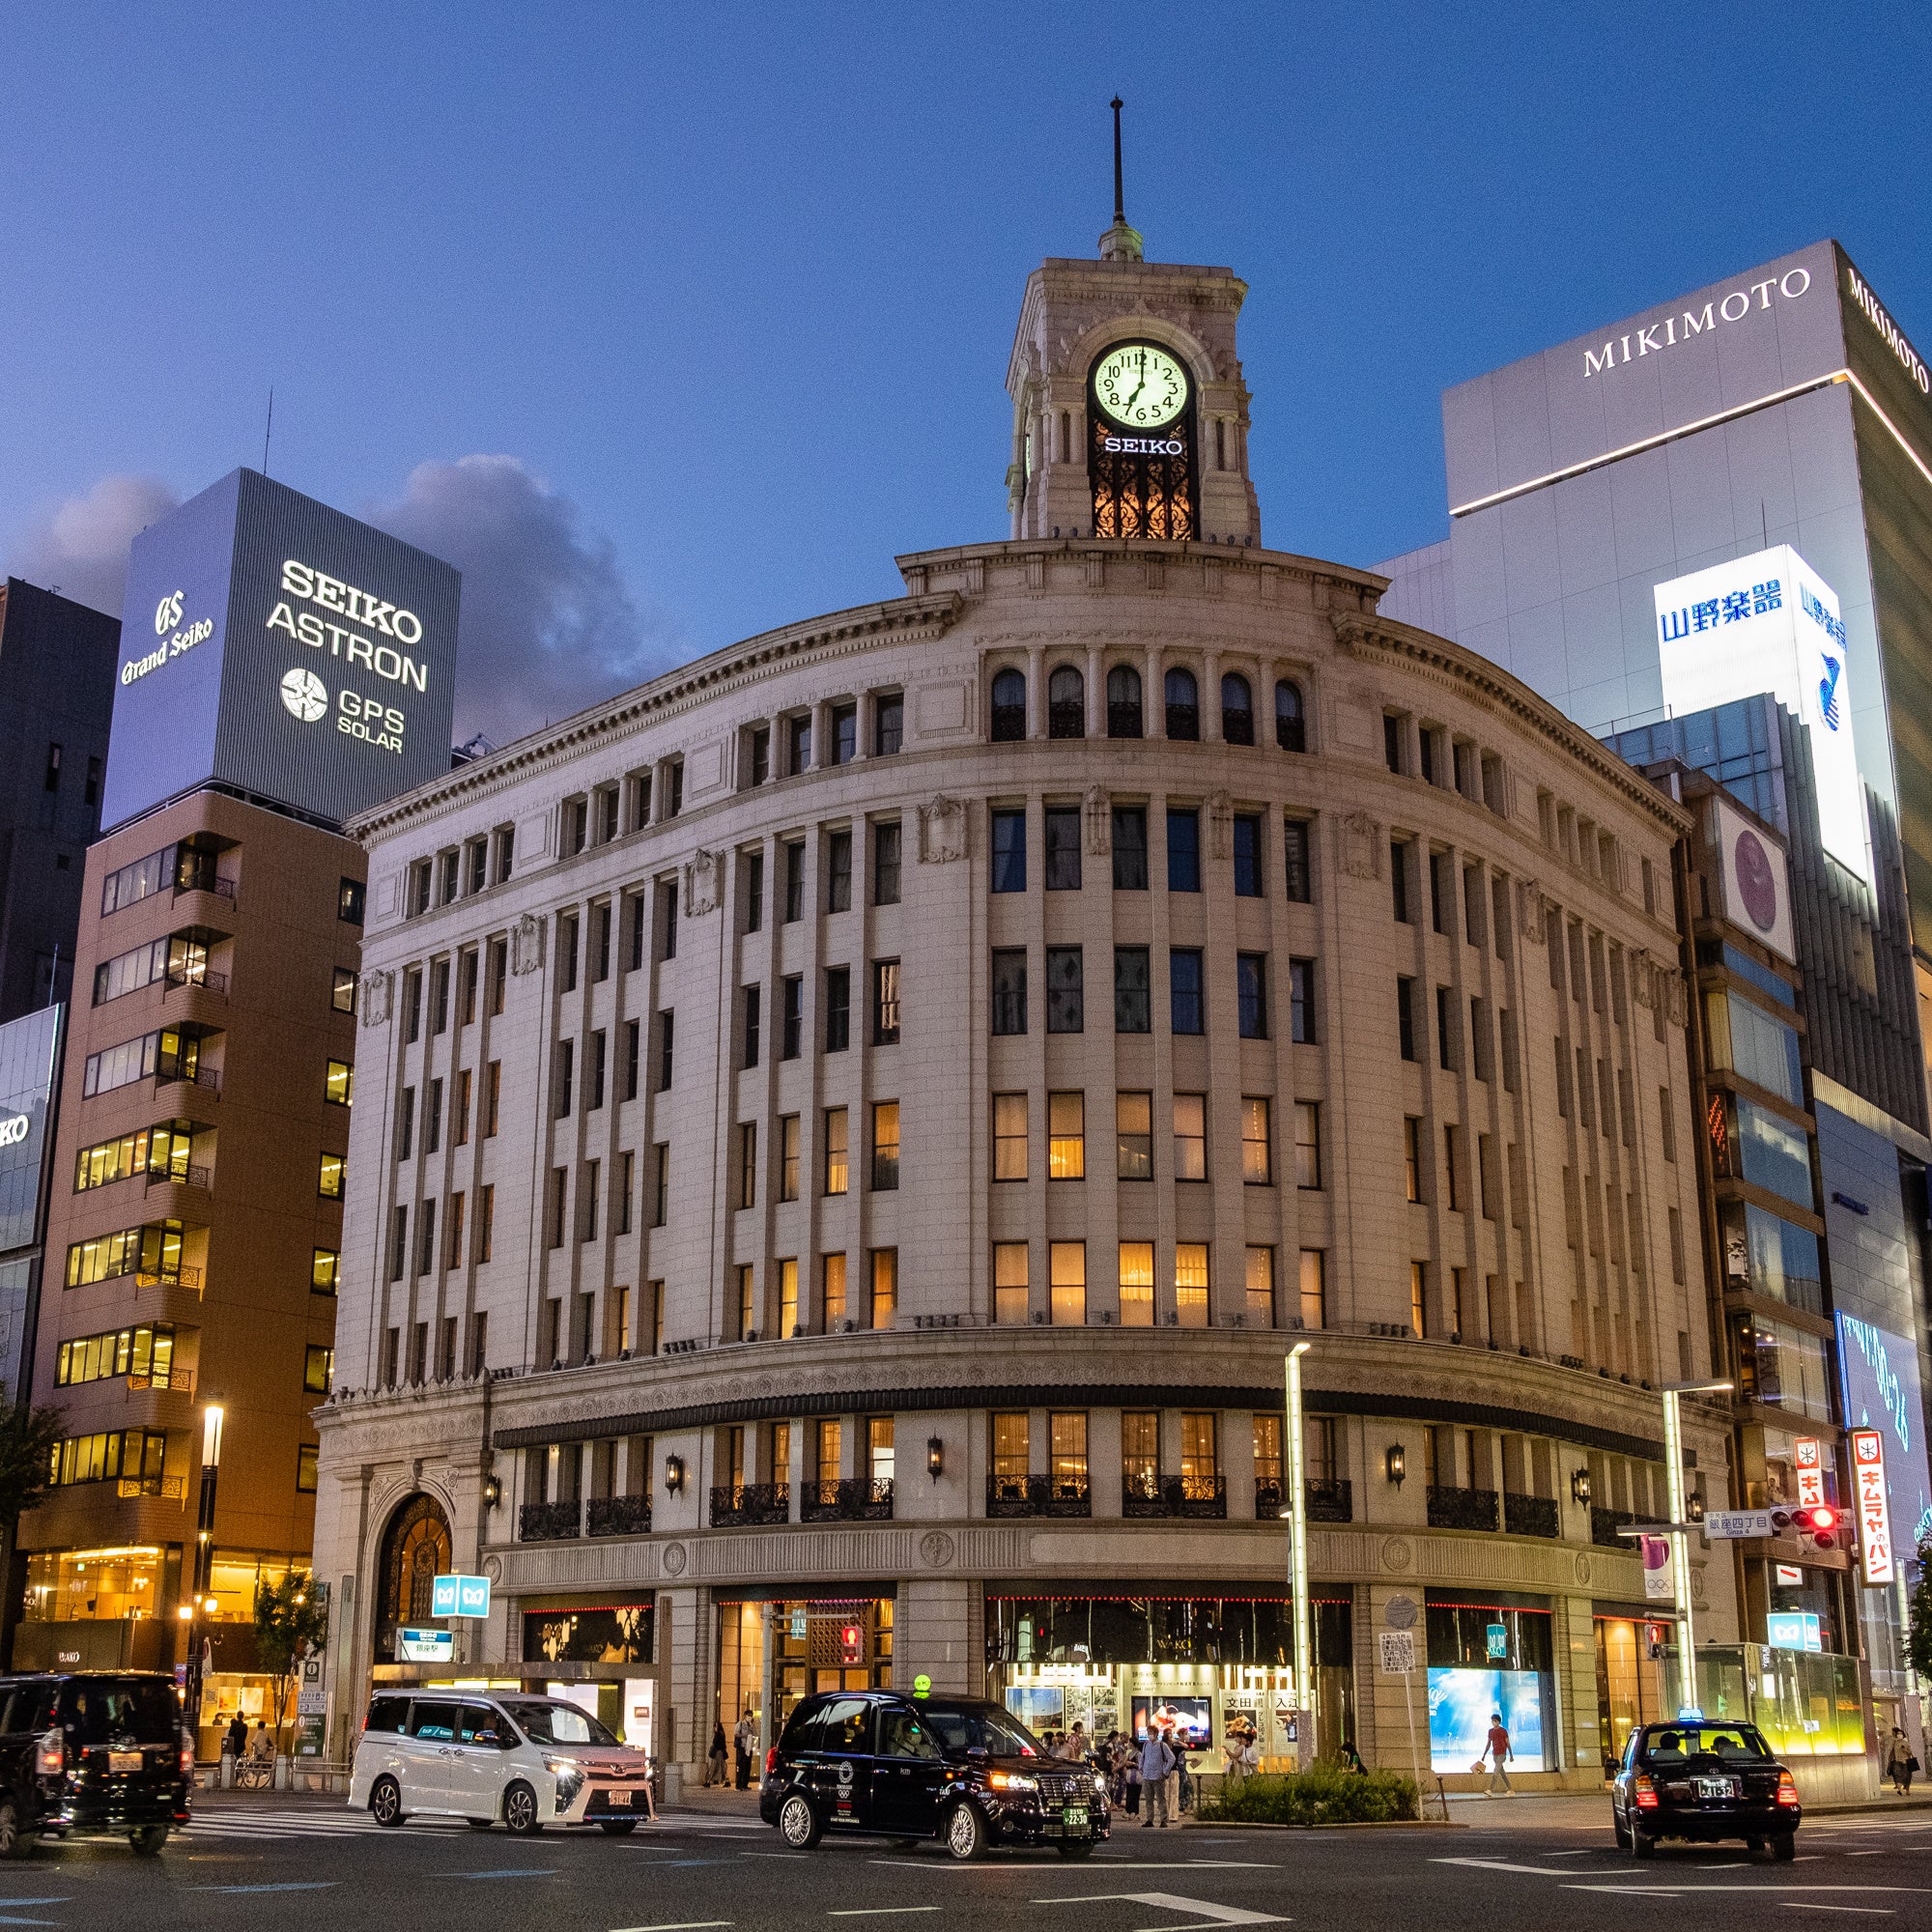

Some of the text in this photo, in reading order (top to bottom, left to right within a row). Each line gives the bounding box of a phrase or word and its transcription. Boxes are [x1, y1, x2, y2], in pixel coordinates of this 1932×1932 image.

[1584, 269, 1811, 377] MIKIMOTO
[1848, 268, 1929, 393] MIKIMOTO
[1108, 366, 1121, 378] 10
[1163, 368, 1173, 380] 2
[1103, 379, 1114, 391] 9
[1169, 383, 1178, 394] 3
[1109, 393, 1120, 405] 8
[1163, 396, 1174, 409] 4
[1136, 408, 1147, 420] 6
[1151, 406, 1161, 417] 5
[1105, 438, 1182, 455] SEIKO
[282, 559, 423, 644] SEIKO
[155, 589, 185, 636] GS
[1661, 579, 1782, 643] 山野楽器
[121, 617, 213, 686] Grand Seiko
[266, 602, 427, 693] ASTRON
[339, 690, 405, 734] GPS
[338, 716, 403, 753] SOLAR
[1710, 1517, 1767, 1529] 銀座四丁目
[1861, 1471, 1889, 1575] キムラヤのパン
[1227, 1697, 1251, 1708] 文田
